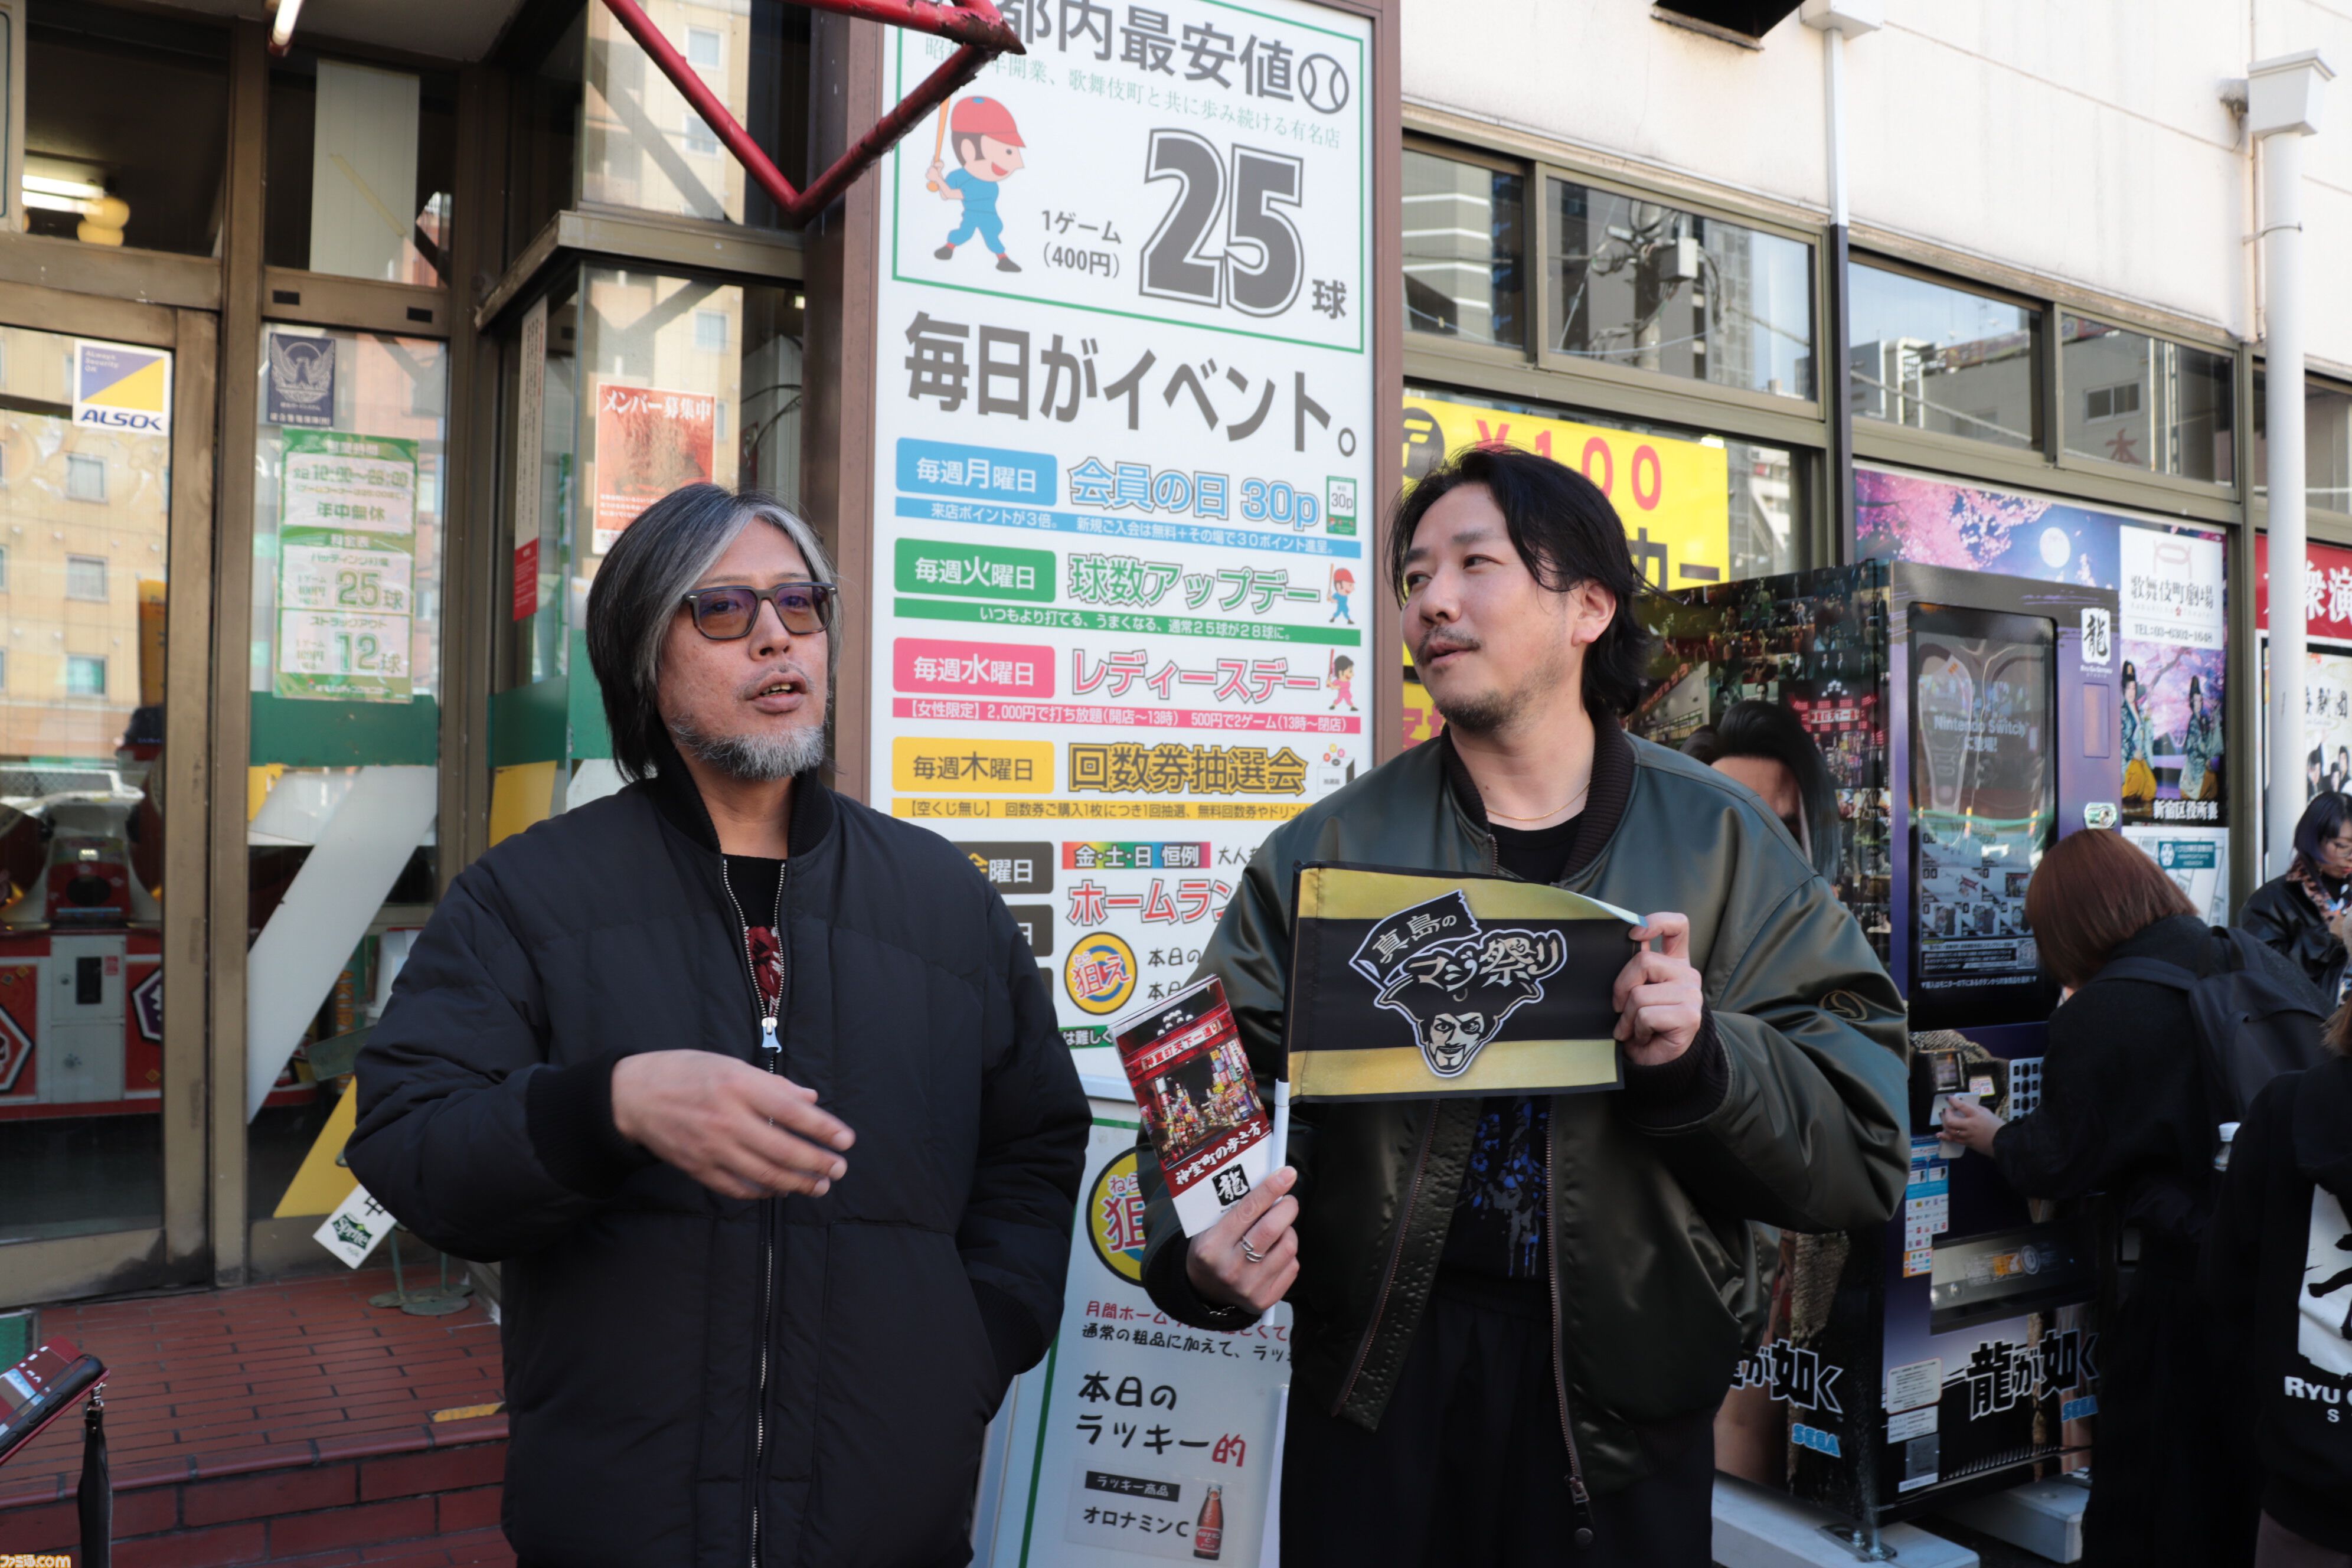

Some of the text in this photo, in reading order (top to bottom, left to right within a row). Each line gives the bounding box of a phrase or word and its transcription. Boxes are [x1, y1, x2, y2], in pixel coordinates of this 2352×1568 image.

[1041, 210, 1122, 244] 1ゲーム
[1139, 127, 1304, 318] 25
[1312, 280, 1347, 319] 球
[904, 311, 1356, 458] 毎日がイベント。
[81, 409, 162, 431] ALSOK
[603, 390, 711, 422] メンバー募集中
[916, 457, 1037, 494] 毎週月曜日
[1067, 457, 1320, 532] 会員の日 30p
[1331, 493, 1353, 510] 30p
[335, 568, 381, 608] 25
[914, 556, 1035, 590] 毎週火曜日
[1068, 553, 1320, 615] 球数アップデー
[2262, 558, 2352, 623] 衆演
[383, 589, 404, 609] 球
[335, 631, 379, 672] 12
[2083, 614, 2108, 658] 龍
[381, 654, 401, 674] 球
[913, 653, 1034, 686] 毎週水曜日
[1072, 648, 1321, 704] レディースデー
[1933, 714, 2026, 737] Nintendo Switch
[913, 751, 1033, 782] 毎週木曜日
[1068, 741, 1309, 797] 回数券抽選会
[1005, 801, 1307, 819] 回数券ご購入1枚につき1回抽選、無料回数券やドリン
[1161, 845, 1200, 867] 恒例
[1372, 913, 1458, 964] 真島の
[1148, 947, 1201, 968] 本日の
[1409, 937, 1560, 993] マジ祭り
[1072, 953, 1132, 1001] 狙え
[1175, 1121, 1261, 1185] 神室町の歩き方
[1218, 1169, 1249, 1201] 龍
[333, 1217, 369, 1246] Sprite
[1078, 1370, 1177, 1410] 本日の
[1730, 1338, 1844, 1415] が如く
[1965, 1329, 2099, 1422] 龍が如く
[2284, 1376, 2340, 1404] RYU
[2061, 1395, 2099, 1422] SEGA
[1076, 1414, 1246, 1468] ラッキー的
[1791, 1423, 1841, 1458] SEGA
[1097, 1476, 1169, 1497] ラッキー商品
[1083, 1506, 1190, 1538] オロナミンC
